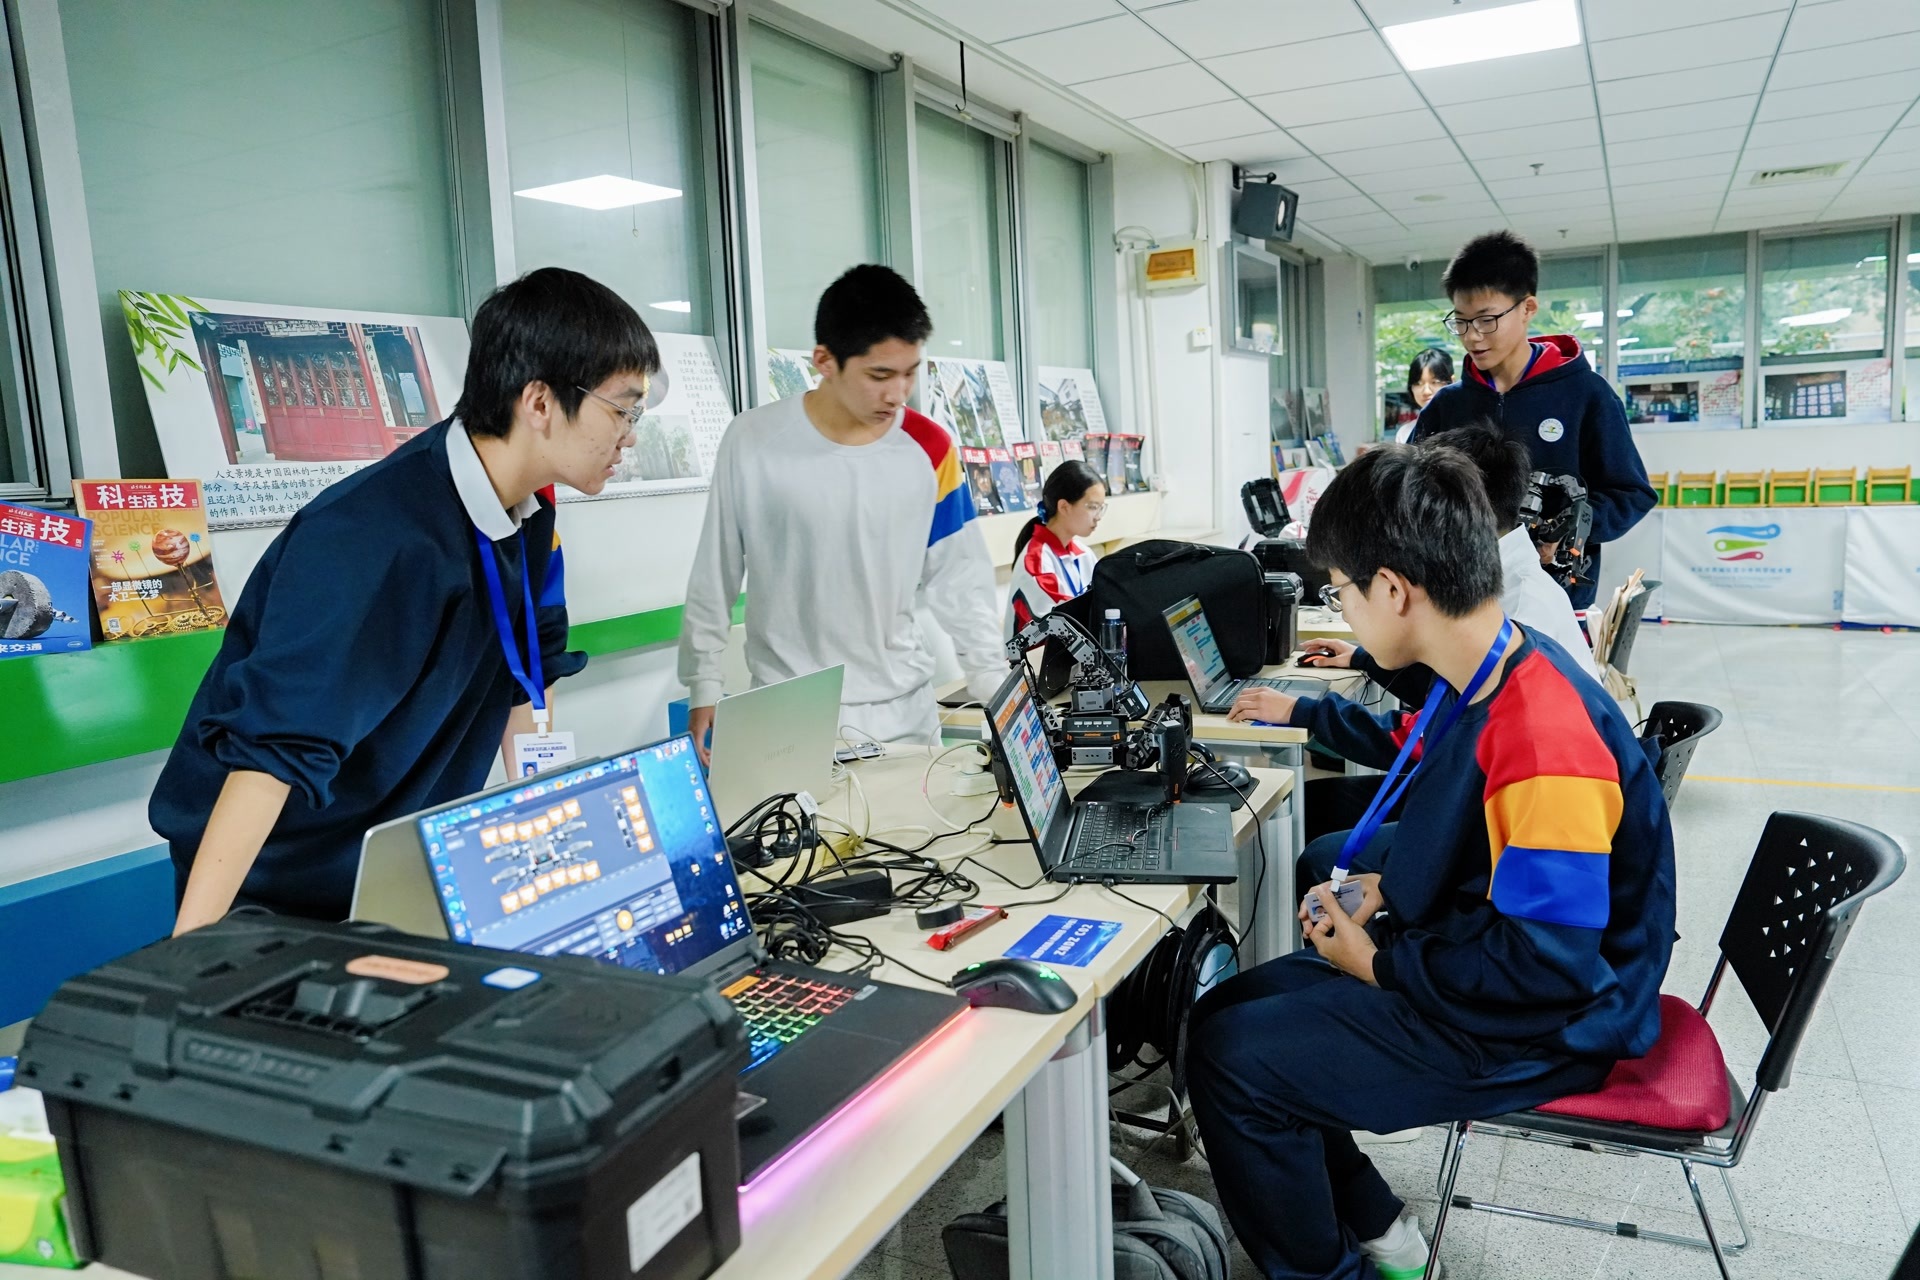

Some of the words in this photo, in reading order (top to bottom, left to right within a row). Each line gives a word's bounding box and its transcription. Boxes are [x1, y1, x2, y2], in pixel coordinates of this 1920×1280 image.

[88, 510, 162, 523] POPULAR
[93, 523, 161, 537] SCIENCE
[108, 589, 160, 602] 木卫二之梦
